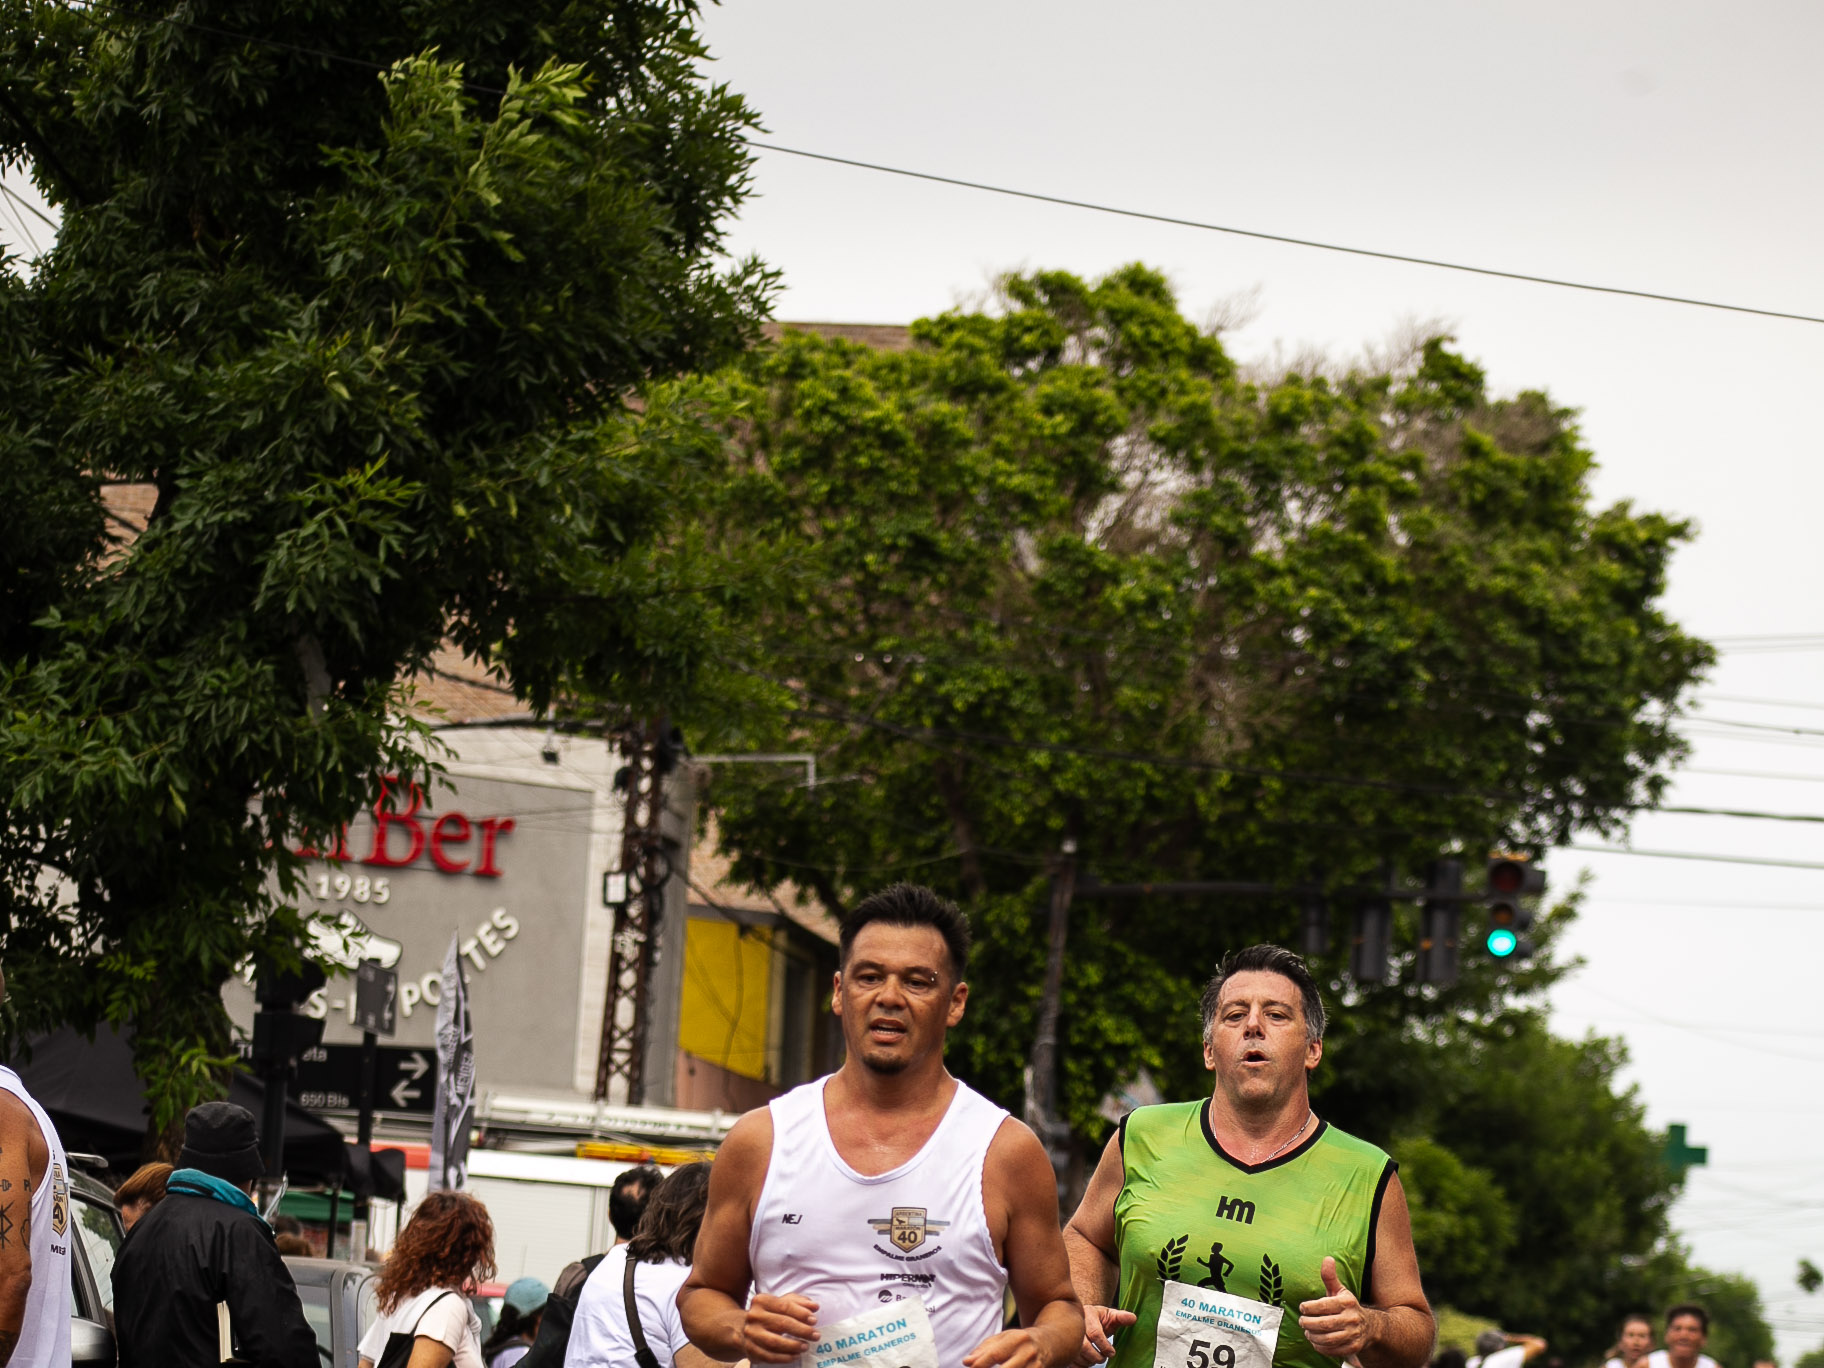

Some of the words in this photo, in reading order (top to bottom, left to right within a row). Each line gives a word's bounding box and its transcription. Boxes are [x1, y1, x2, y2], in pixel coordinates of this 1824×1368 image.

[316, 873, 391, 905] 1985
[781, 1213, 803, 1225] NEJ
[897, 1231, 918, 1244] 40
[1175, 1310, 1215, 1325] EMPALME
[1181, 1298, 1196, 1309] 40
[1199, 1302, 1262, 1325] MARATON
[816, 1342, 833, 1355] 40
[835, 1318, 907, 1350] MARATON
[816, 1351, 861, 1368] EMPALME
[863, 1332, 917, 1357] GRANEROS
